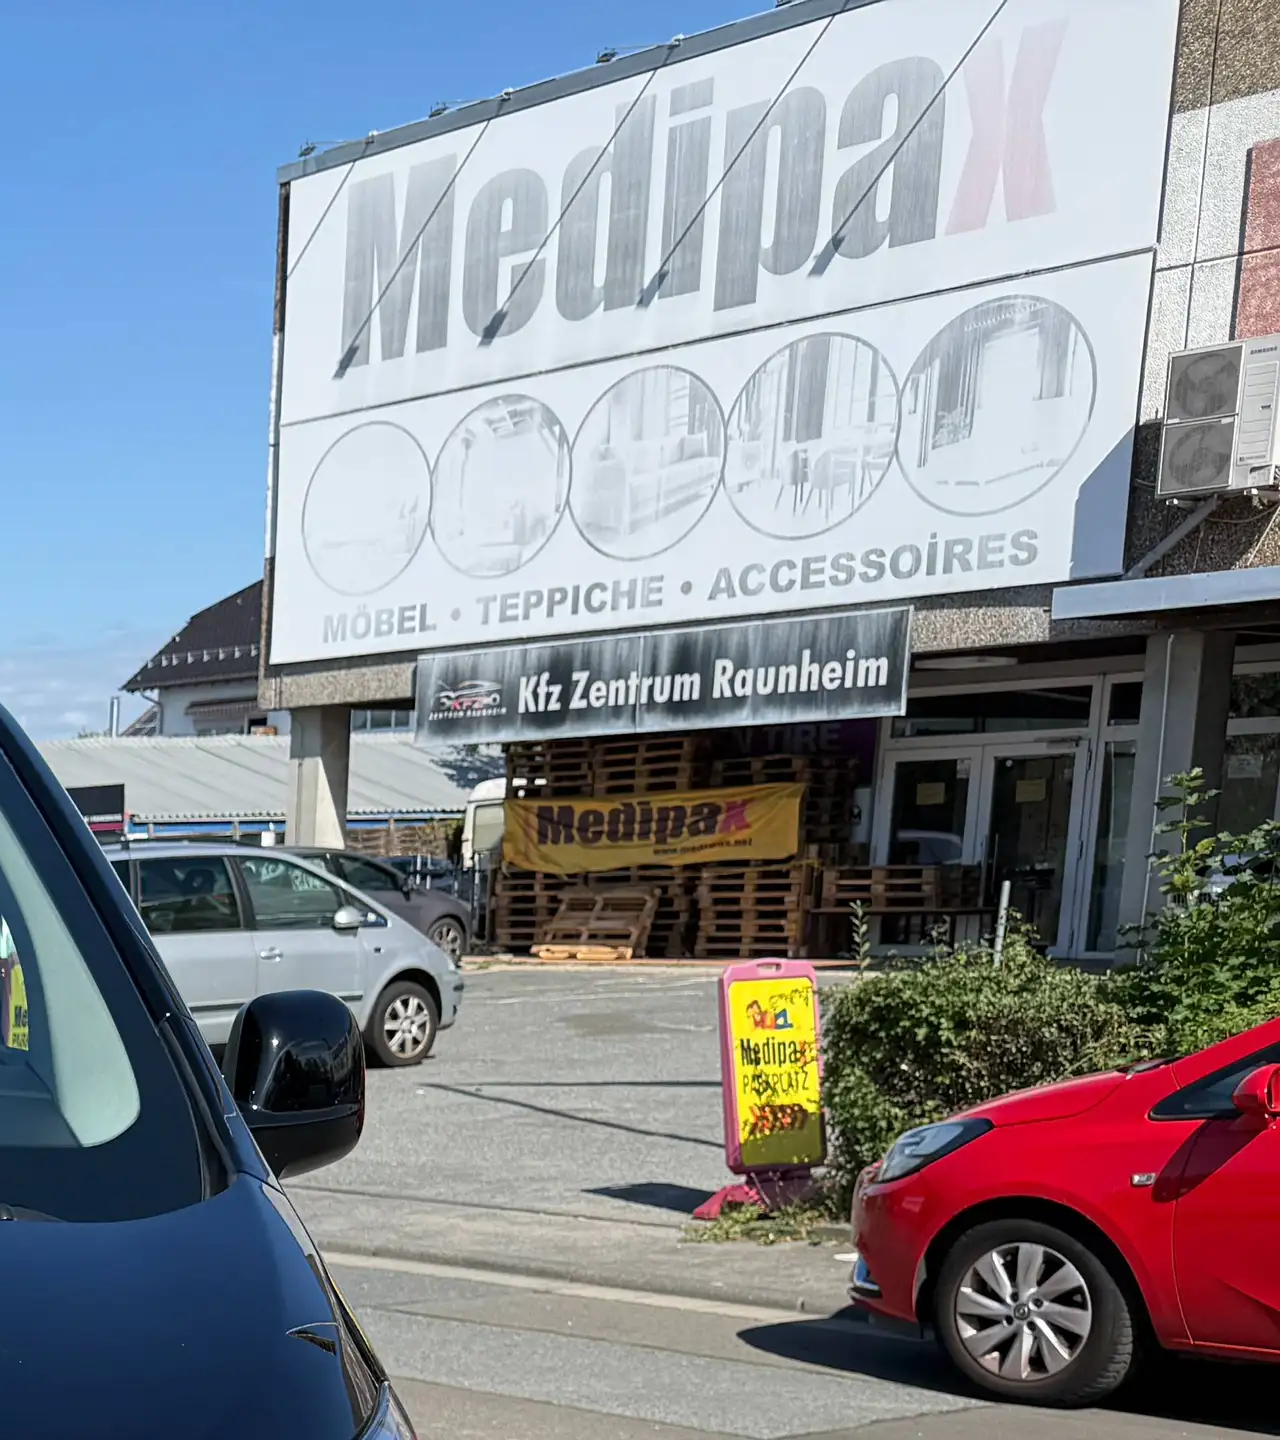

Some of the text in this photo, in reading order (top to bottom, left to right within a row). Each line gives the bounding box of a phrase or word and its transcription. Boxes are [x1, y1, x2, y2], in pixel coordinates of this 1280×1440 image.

[341, 17, 1071, 368] Medipax
[322, 602, 437, 643] MÖBEL
[476, 574, 665, 625] TEPPICHE
[518, 649, 888, 714] Kfz Zentrum Raunheim
[537, 799, 755, 845] Medipax
